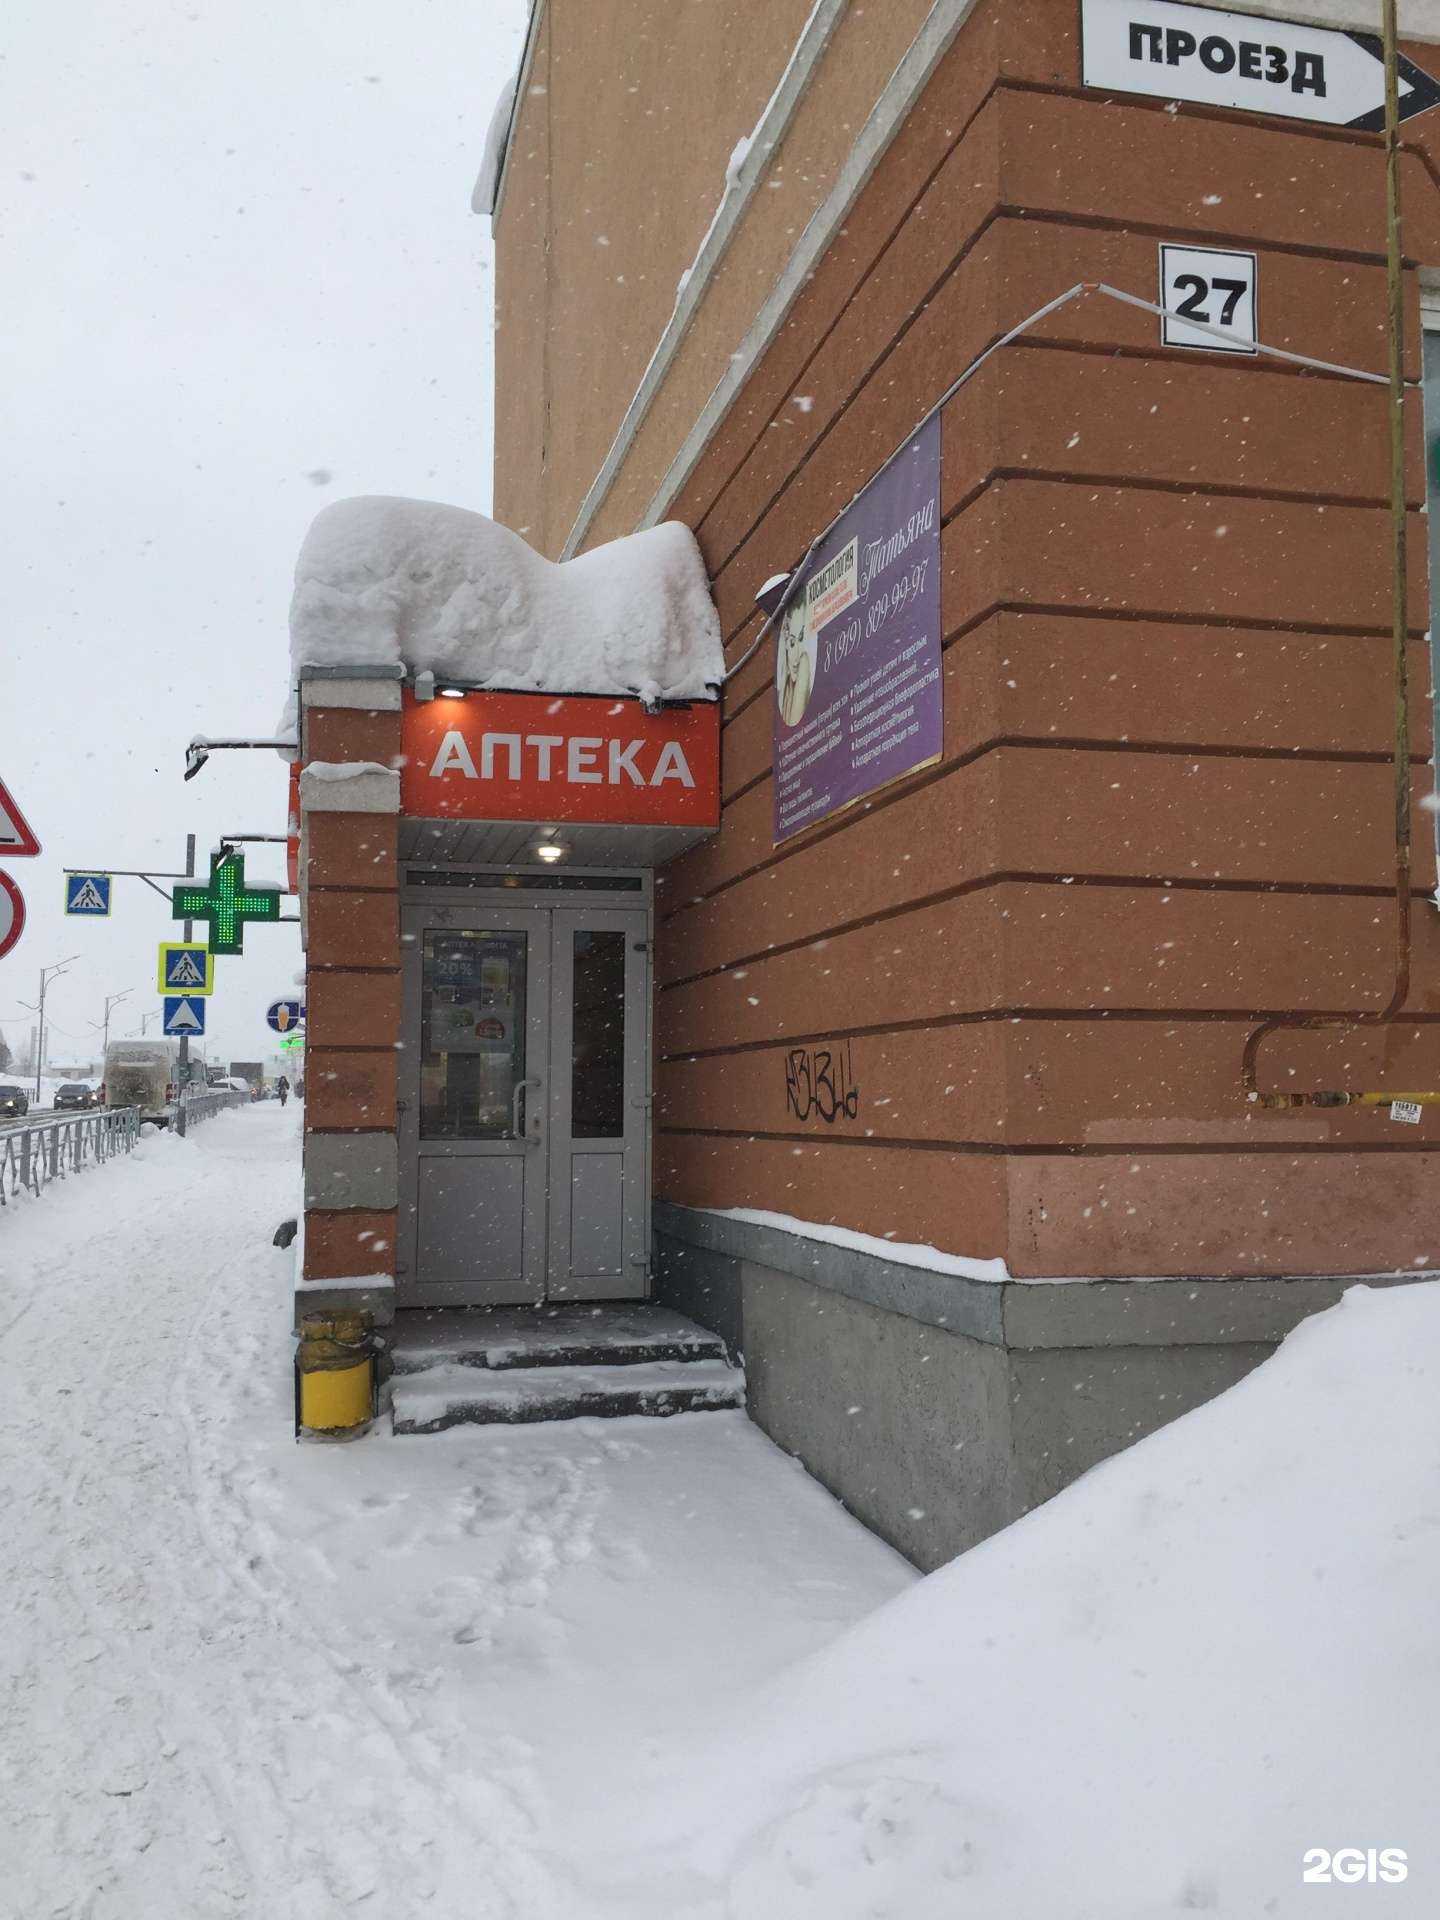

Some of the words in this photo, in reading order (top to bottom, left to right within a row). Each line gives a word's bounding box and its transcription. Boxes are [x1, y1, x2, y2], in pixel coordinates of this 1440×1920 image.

[1128, 22, 1327, 98] ПРОЕЗД
[1172, 273, 1248, 326] 27
[860, 498, 935, 603] Татьяна
[824, 640, 833, 672] 8
[834, 617, 862, 665] (919)
[865, 557, 929, 639] 809-99-97
[428, 730, 697, 788] АПТЕКА
